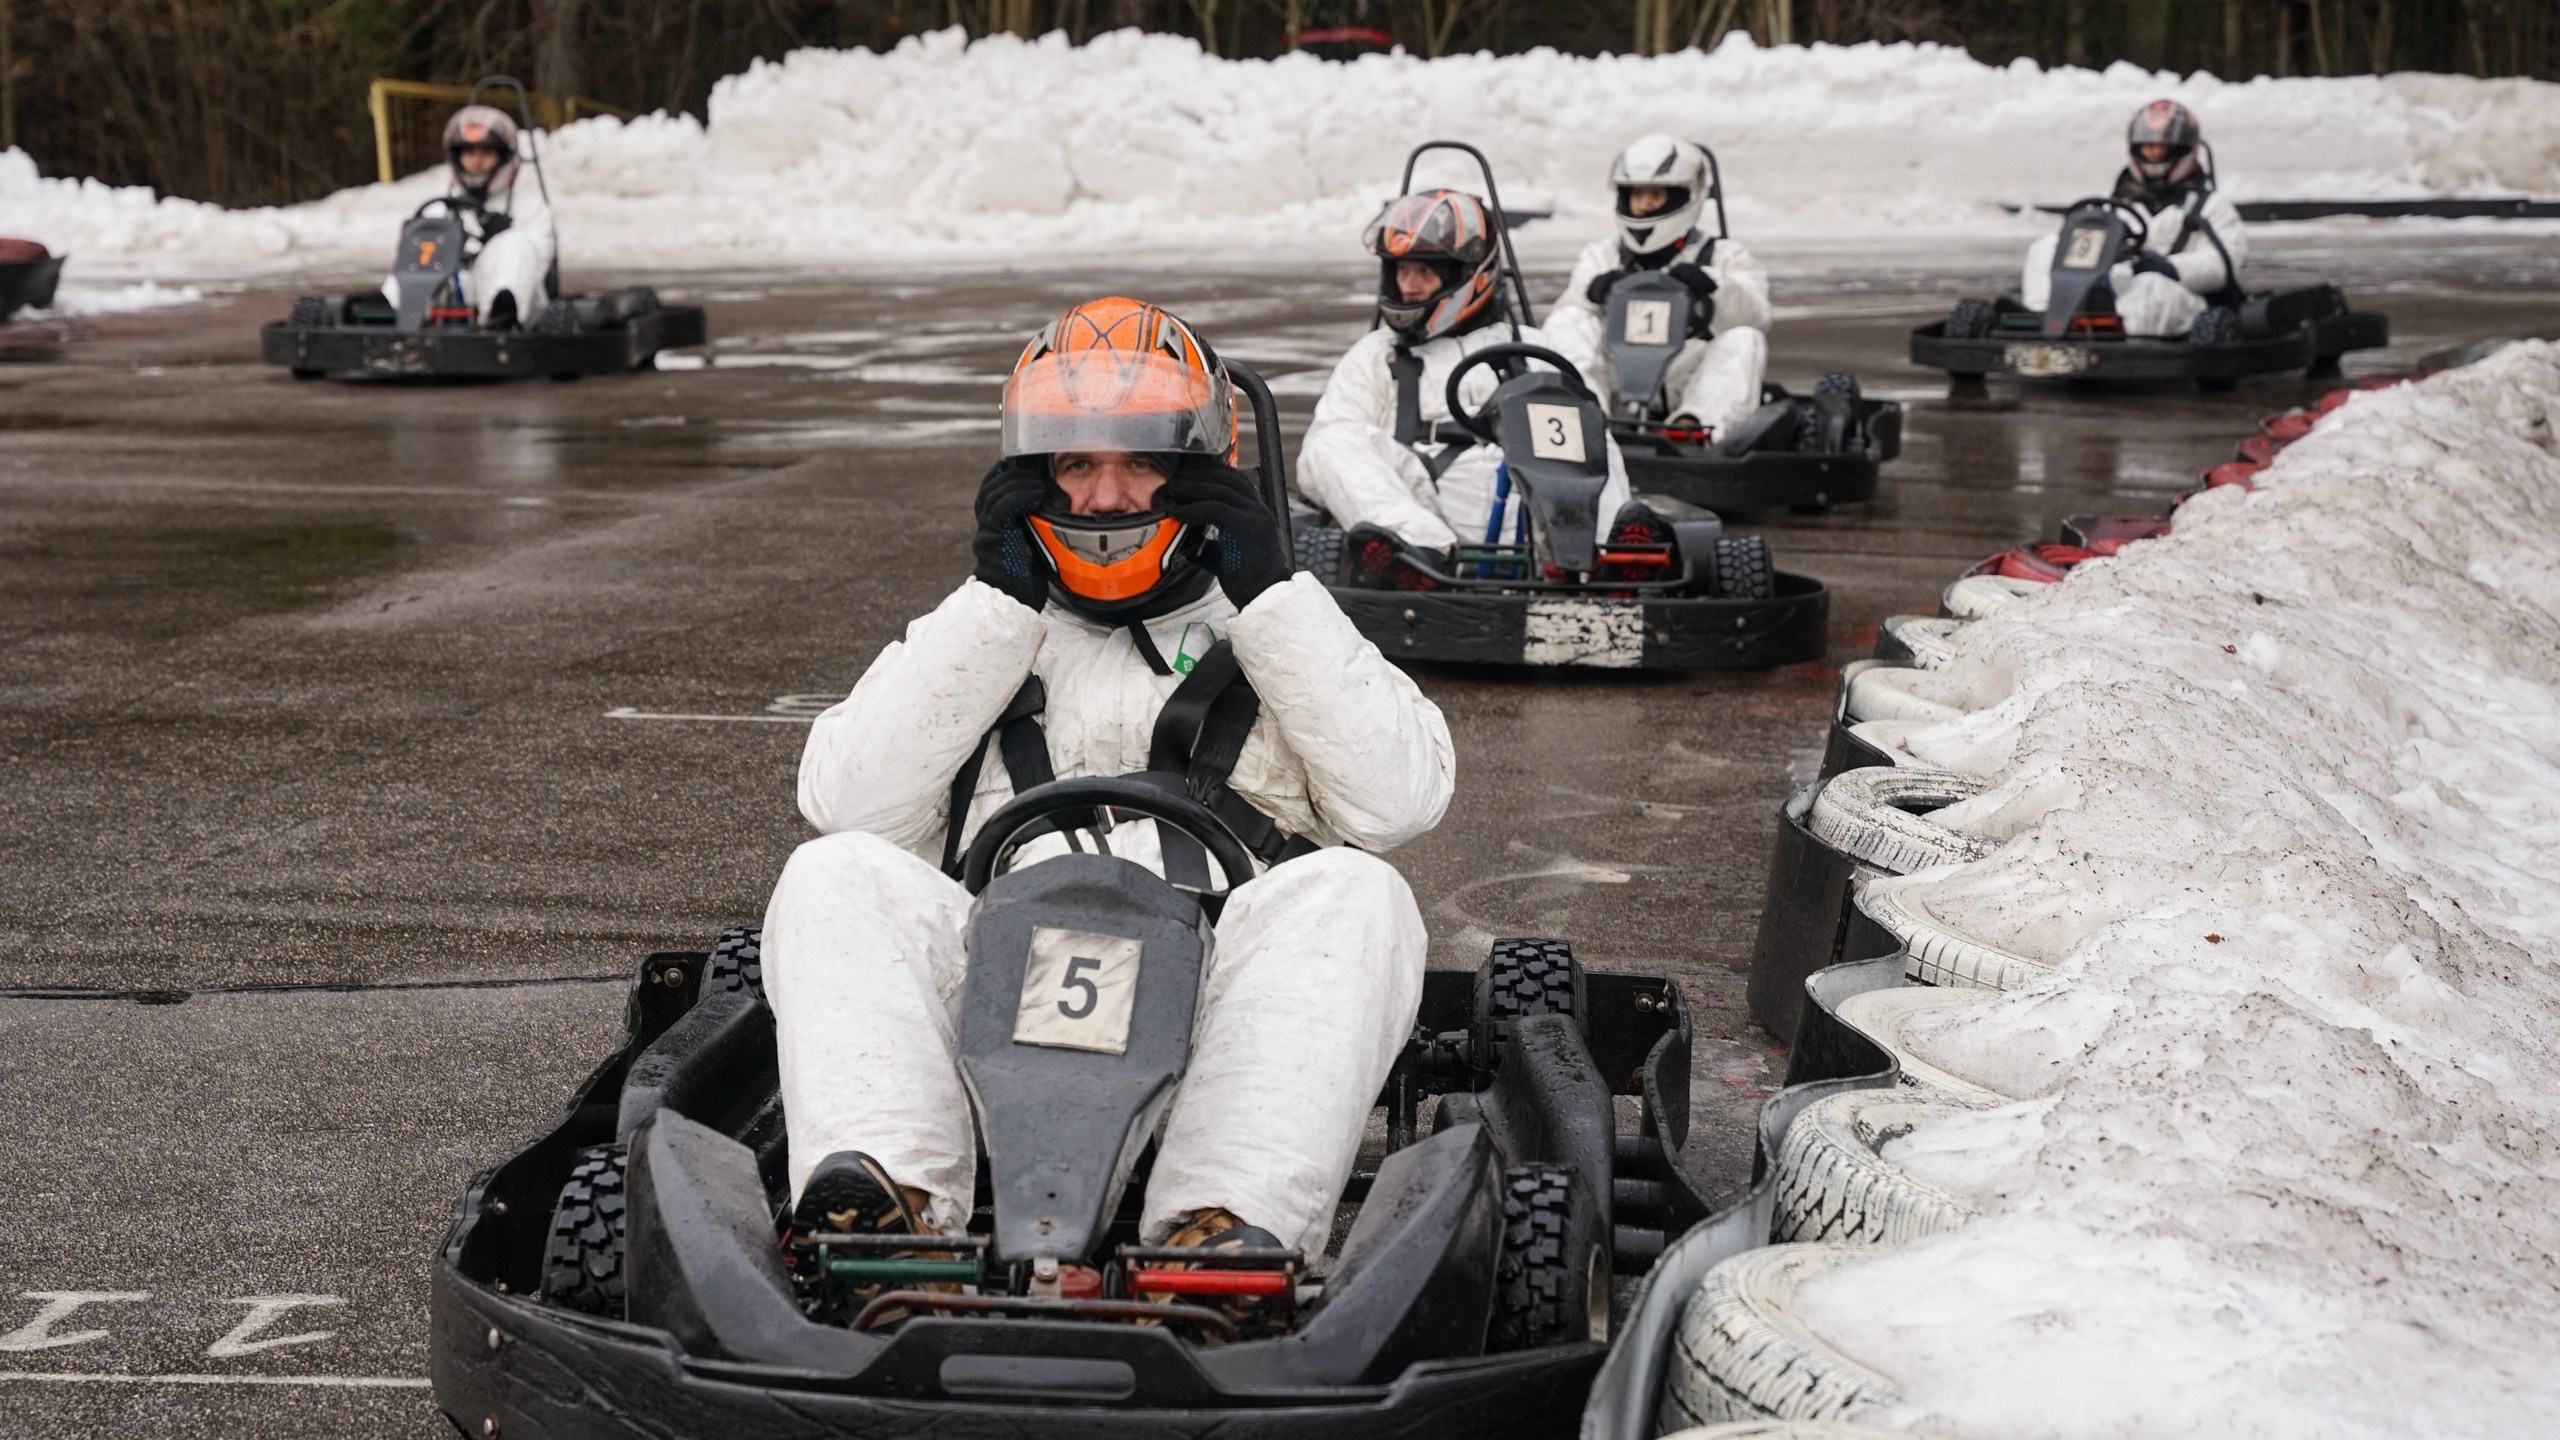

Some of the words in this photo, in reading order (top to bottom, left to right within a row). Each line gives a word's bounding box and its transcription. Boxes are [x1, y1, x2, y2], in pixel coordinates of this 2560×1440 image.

[420, 241, 437, 266] 7
[1643, 311, 1654, 334] 1
[1548, 417, 1566, 447] 3
[1057, 956, 1102, 1020] 5
